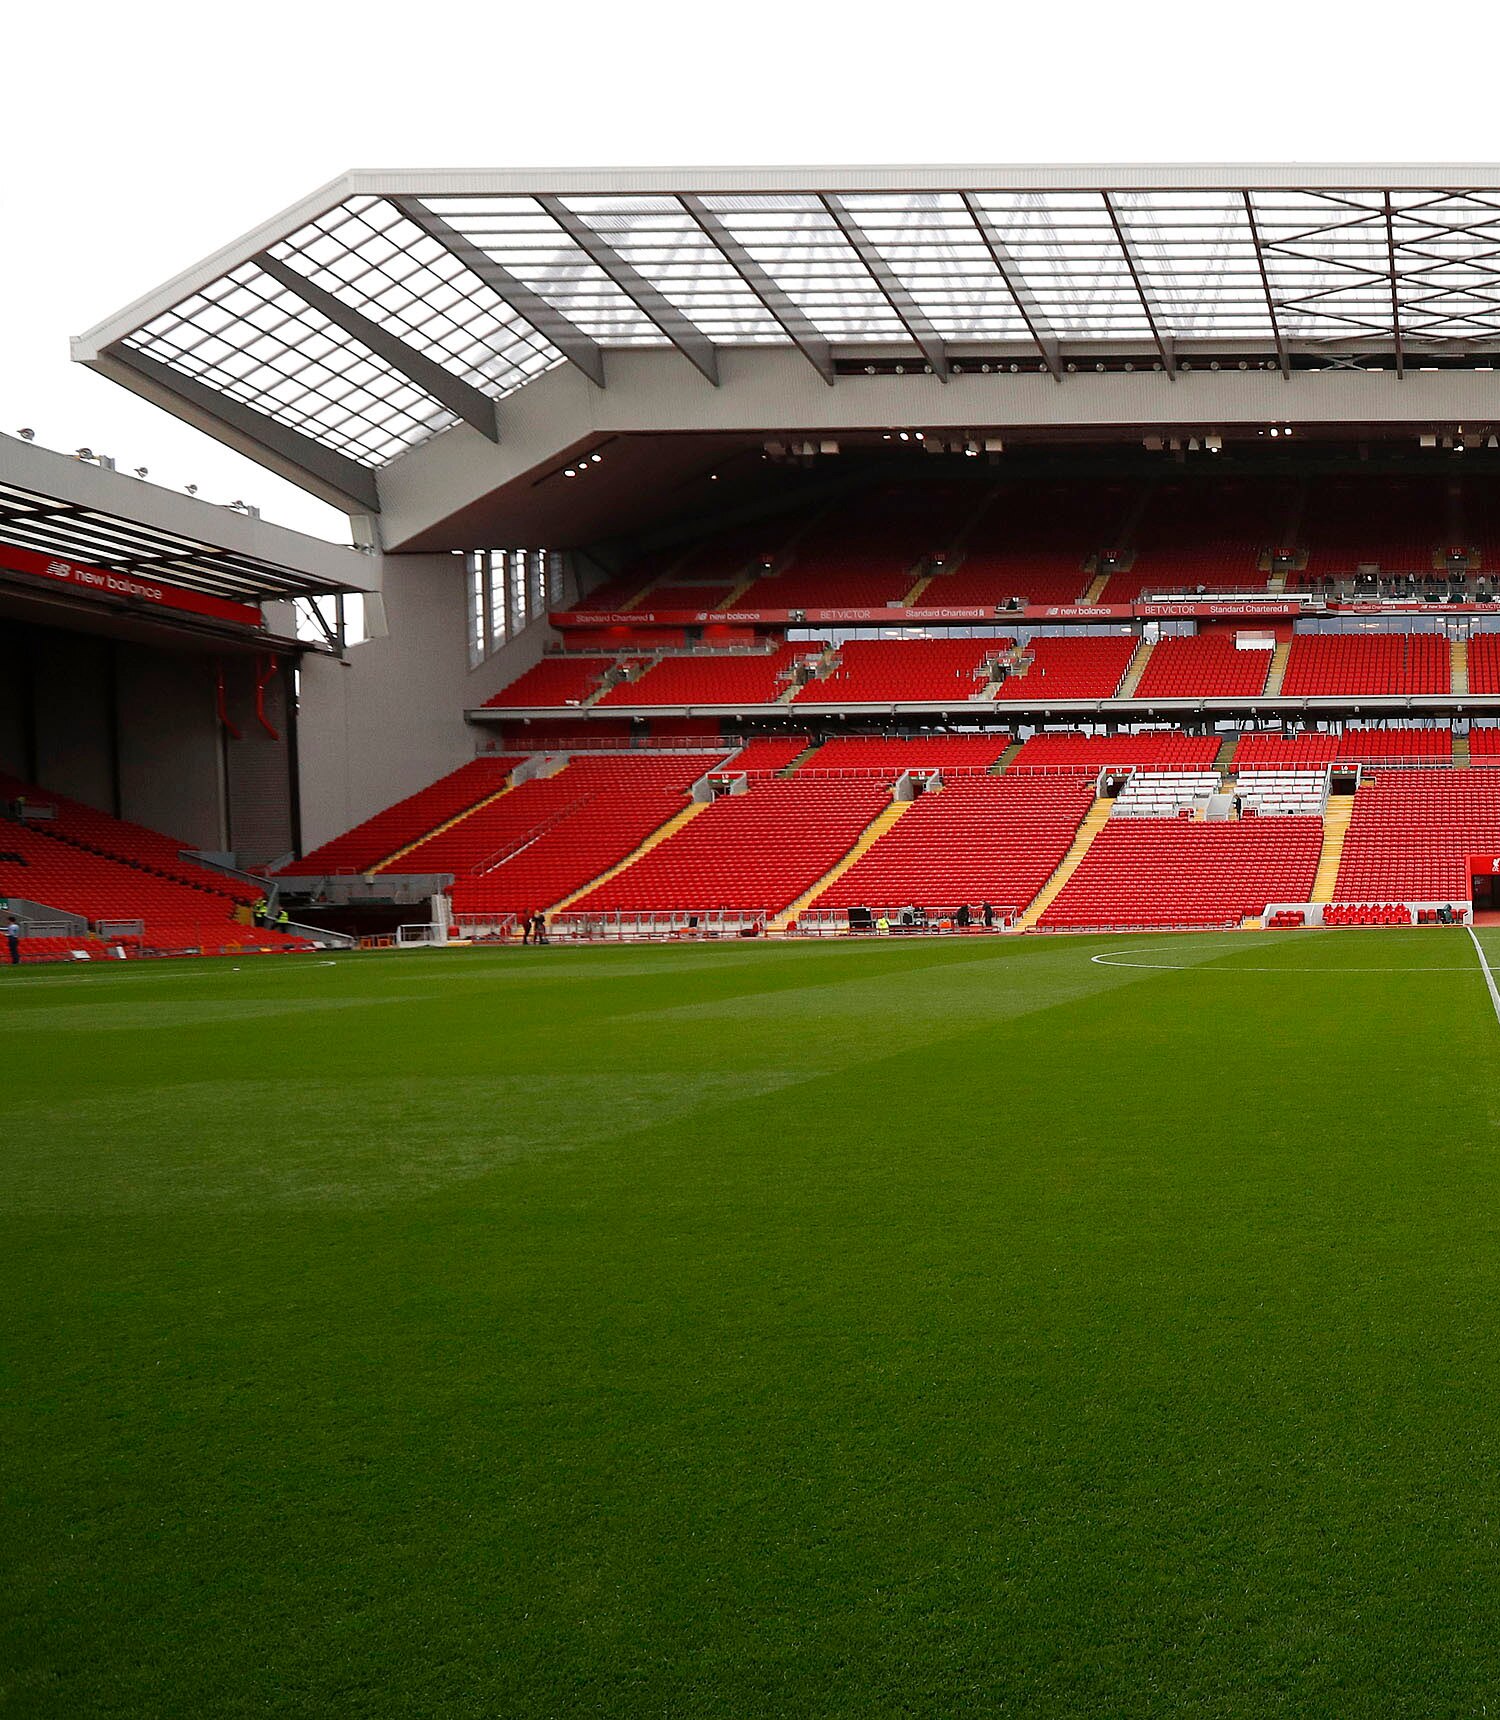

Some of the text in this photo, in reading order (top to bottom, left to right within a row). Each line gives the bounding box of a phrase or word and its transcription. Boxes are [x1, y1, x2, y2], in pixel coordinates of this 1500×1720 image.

[74, 569, 104, 586] new
[107, 574, 162, 599] balance
[1078, 607, 1111, 616] balance
[1210, 605, 1282, 613] Standard Chartered
[576, 614, 648, 622] Standard Chartered
[727, 612, 760, 620] balance
[906, 610, 978, 618] Standard Chartered
